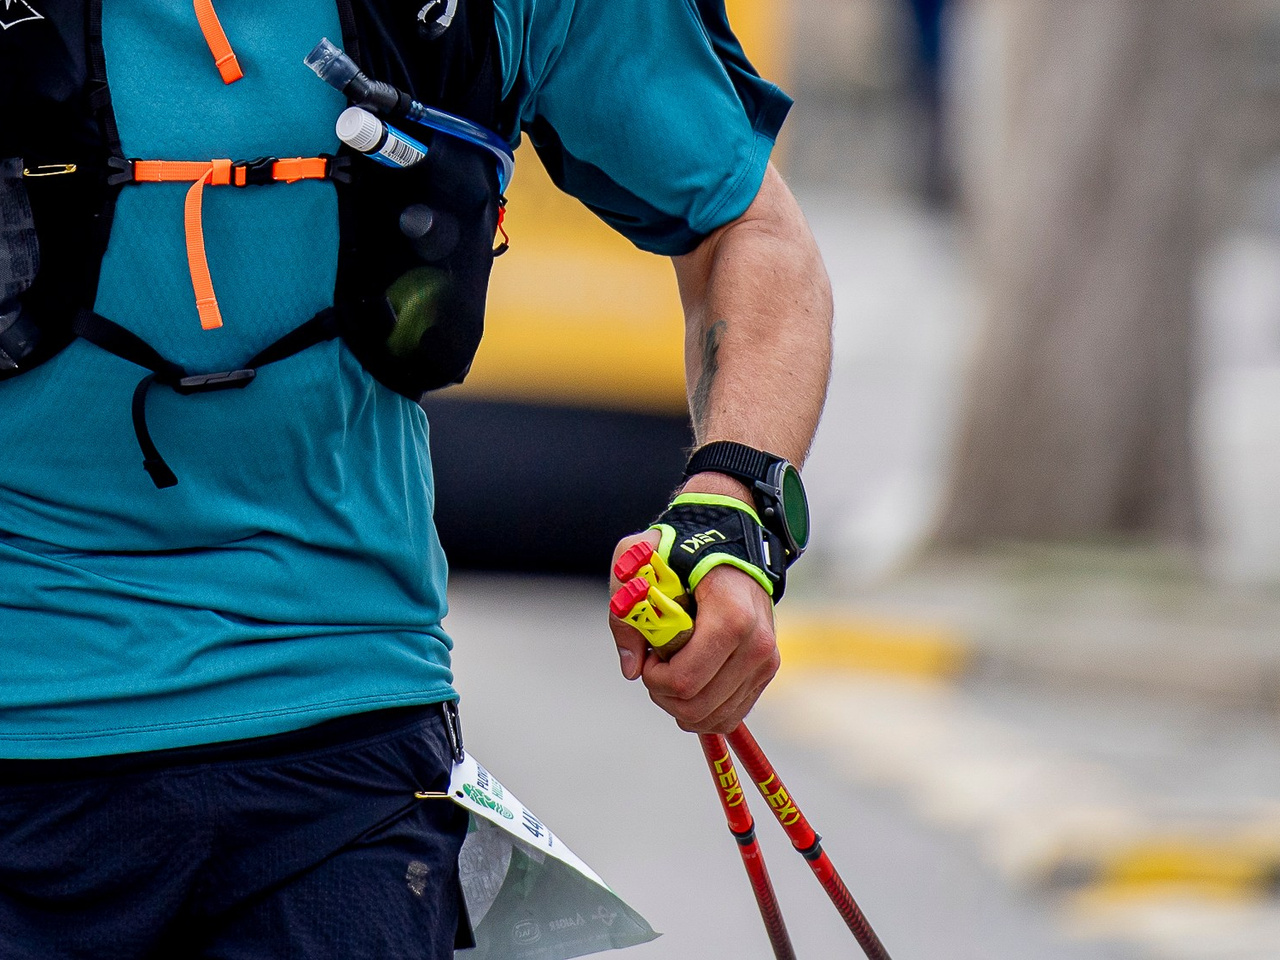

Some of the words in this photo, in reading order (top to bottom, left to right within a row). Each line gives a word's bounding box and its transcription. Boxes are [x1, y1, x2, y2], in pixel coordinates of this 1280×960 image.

[680, 529, 726, 554] LEKI
[714, 750, 744, 807] LEKI
[758, 773, 800, 826] LEKI
